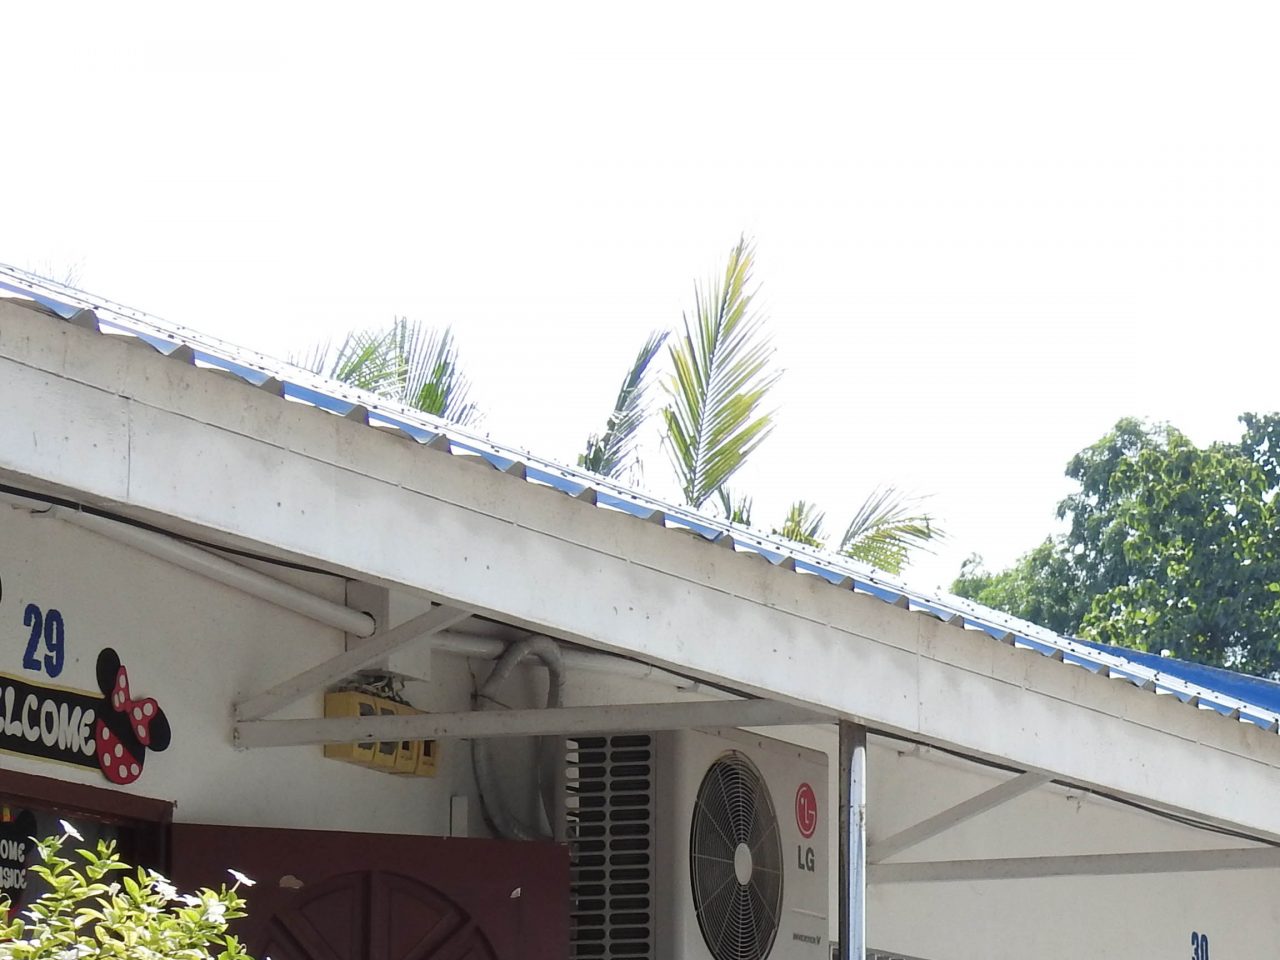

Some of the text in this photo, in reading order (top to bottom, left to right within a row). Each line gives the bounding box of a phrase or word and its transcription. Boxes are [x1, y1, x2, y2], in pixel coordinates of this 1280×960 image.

[23, 603, 64, 678] 29
[0, 686, 96, 756] LCOME
[798, 845, 815, 873] LG
